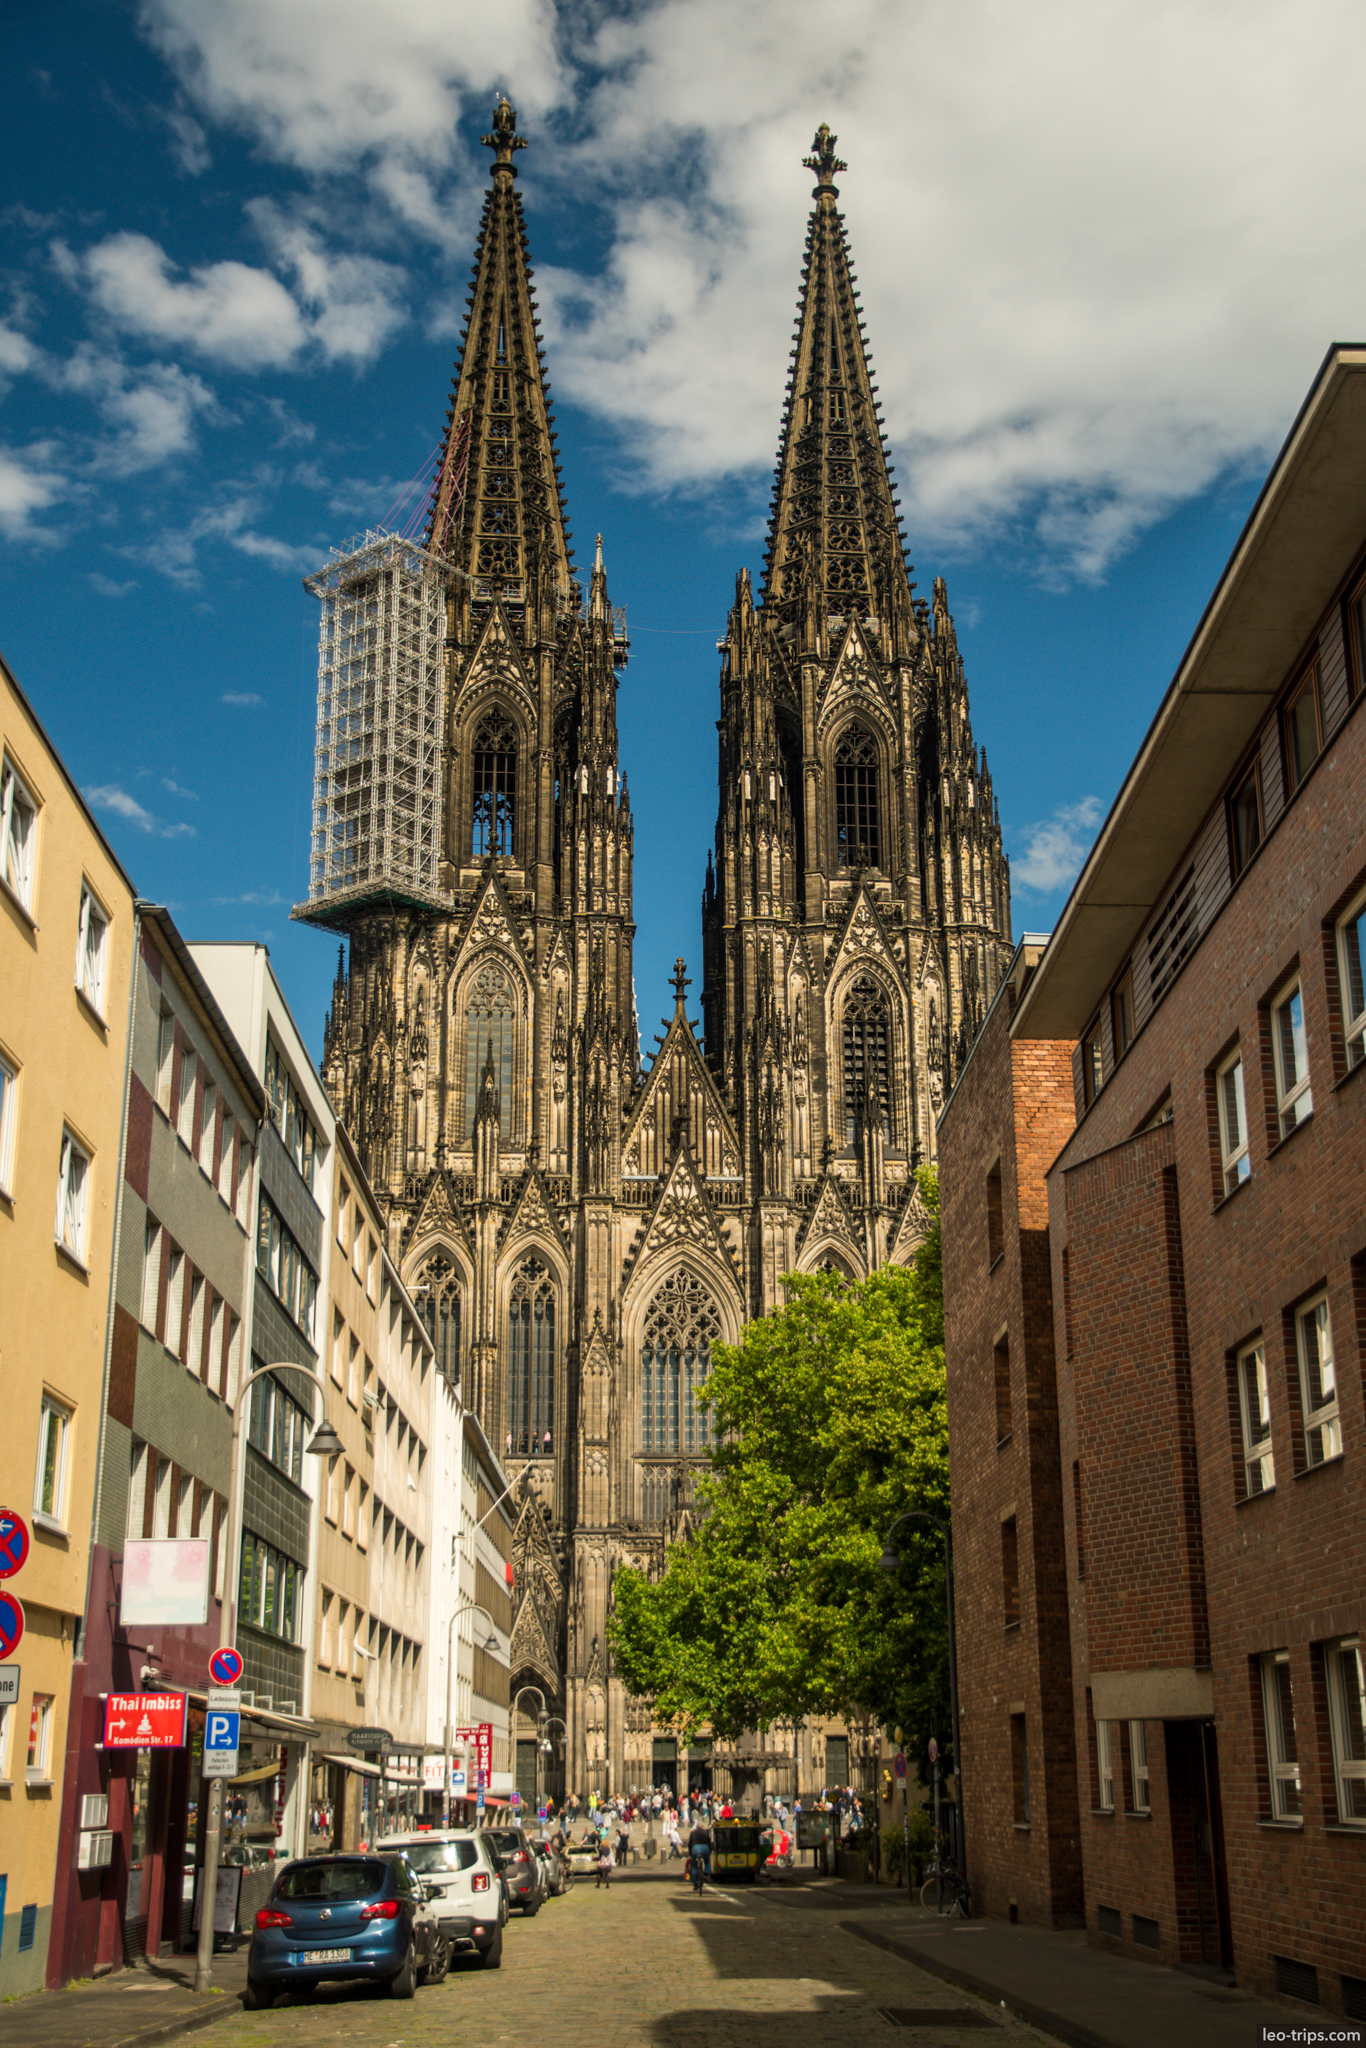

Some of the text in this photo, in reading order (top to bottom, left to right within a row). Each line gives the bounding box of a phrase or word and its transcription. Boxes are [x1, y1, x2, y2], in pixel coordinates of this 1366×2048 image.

[111, 1696, 181, 1711] Thai Imbiss
[210, 1695, 239, 1703] Ladezone
[210, 1717, 230, 1745] P
[113, 1735, 174, 1744] Komödien Str. 17
[304, 1951, 314, 1961] ME
[319, 1950, 329, 1959] RA
